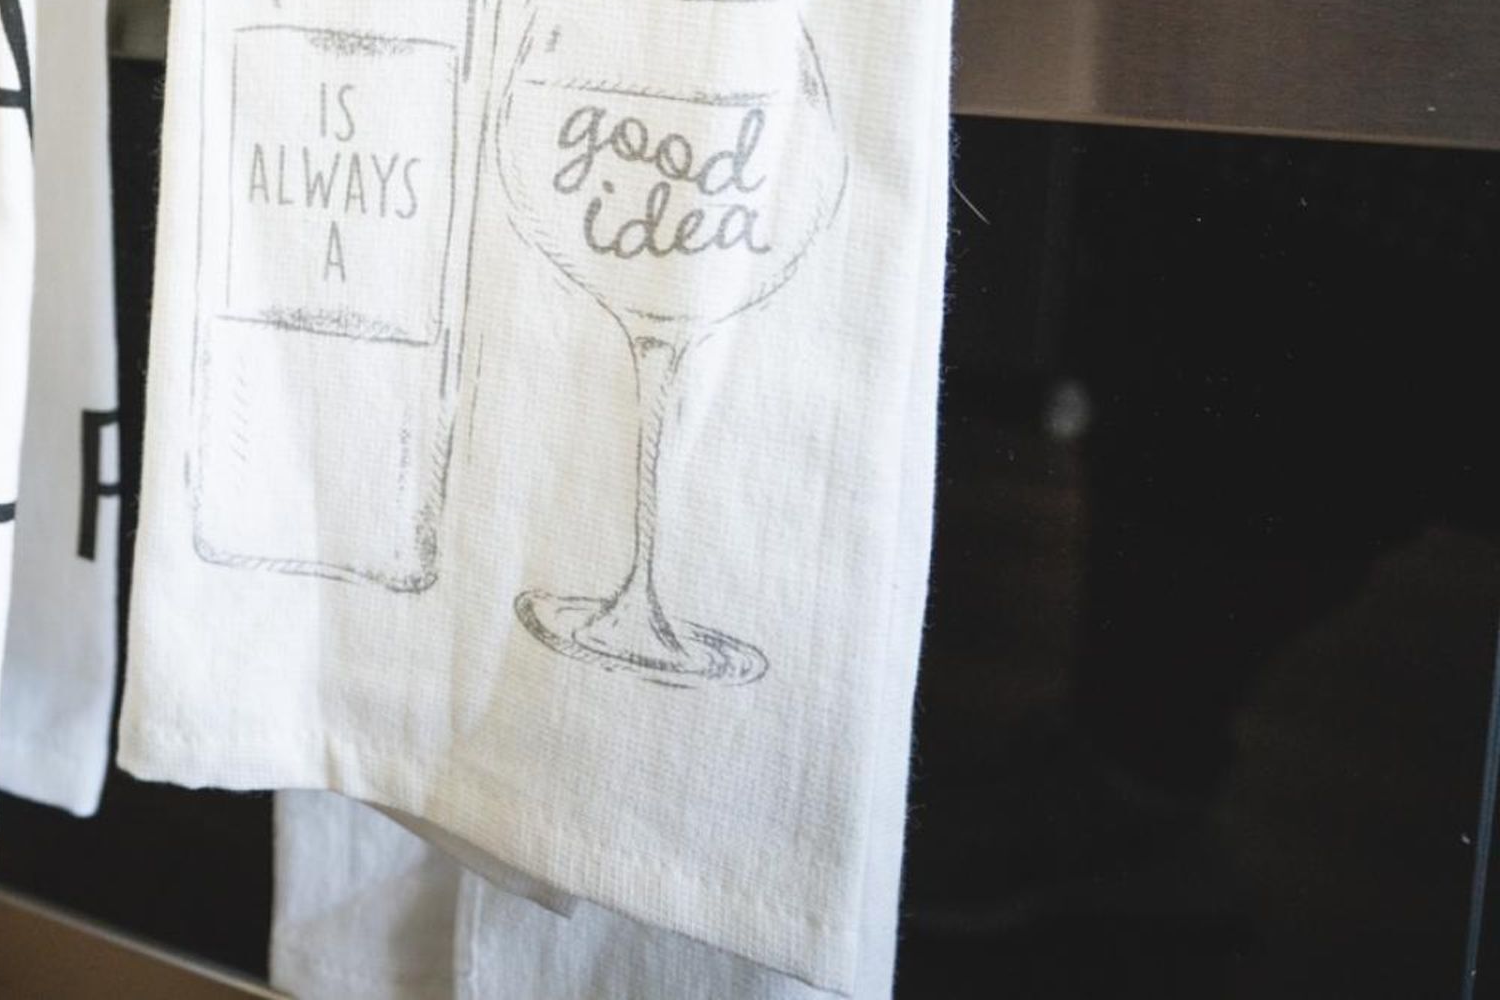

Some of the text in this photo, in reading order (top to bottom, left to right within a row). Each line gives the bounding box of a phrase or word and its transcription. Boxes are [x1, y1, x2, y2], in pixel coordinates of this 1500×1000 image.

[318, 82, 356, 143] IS
[552, 103, 768, 195] good
[248, 142, 423, 222] ALWAYS
[583, 180, 772, 261] idea
[321, 219, 348, 284] A
